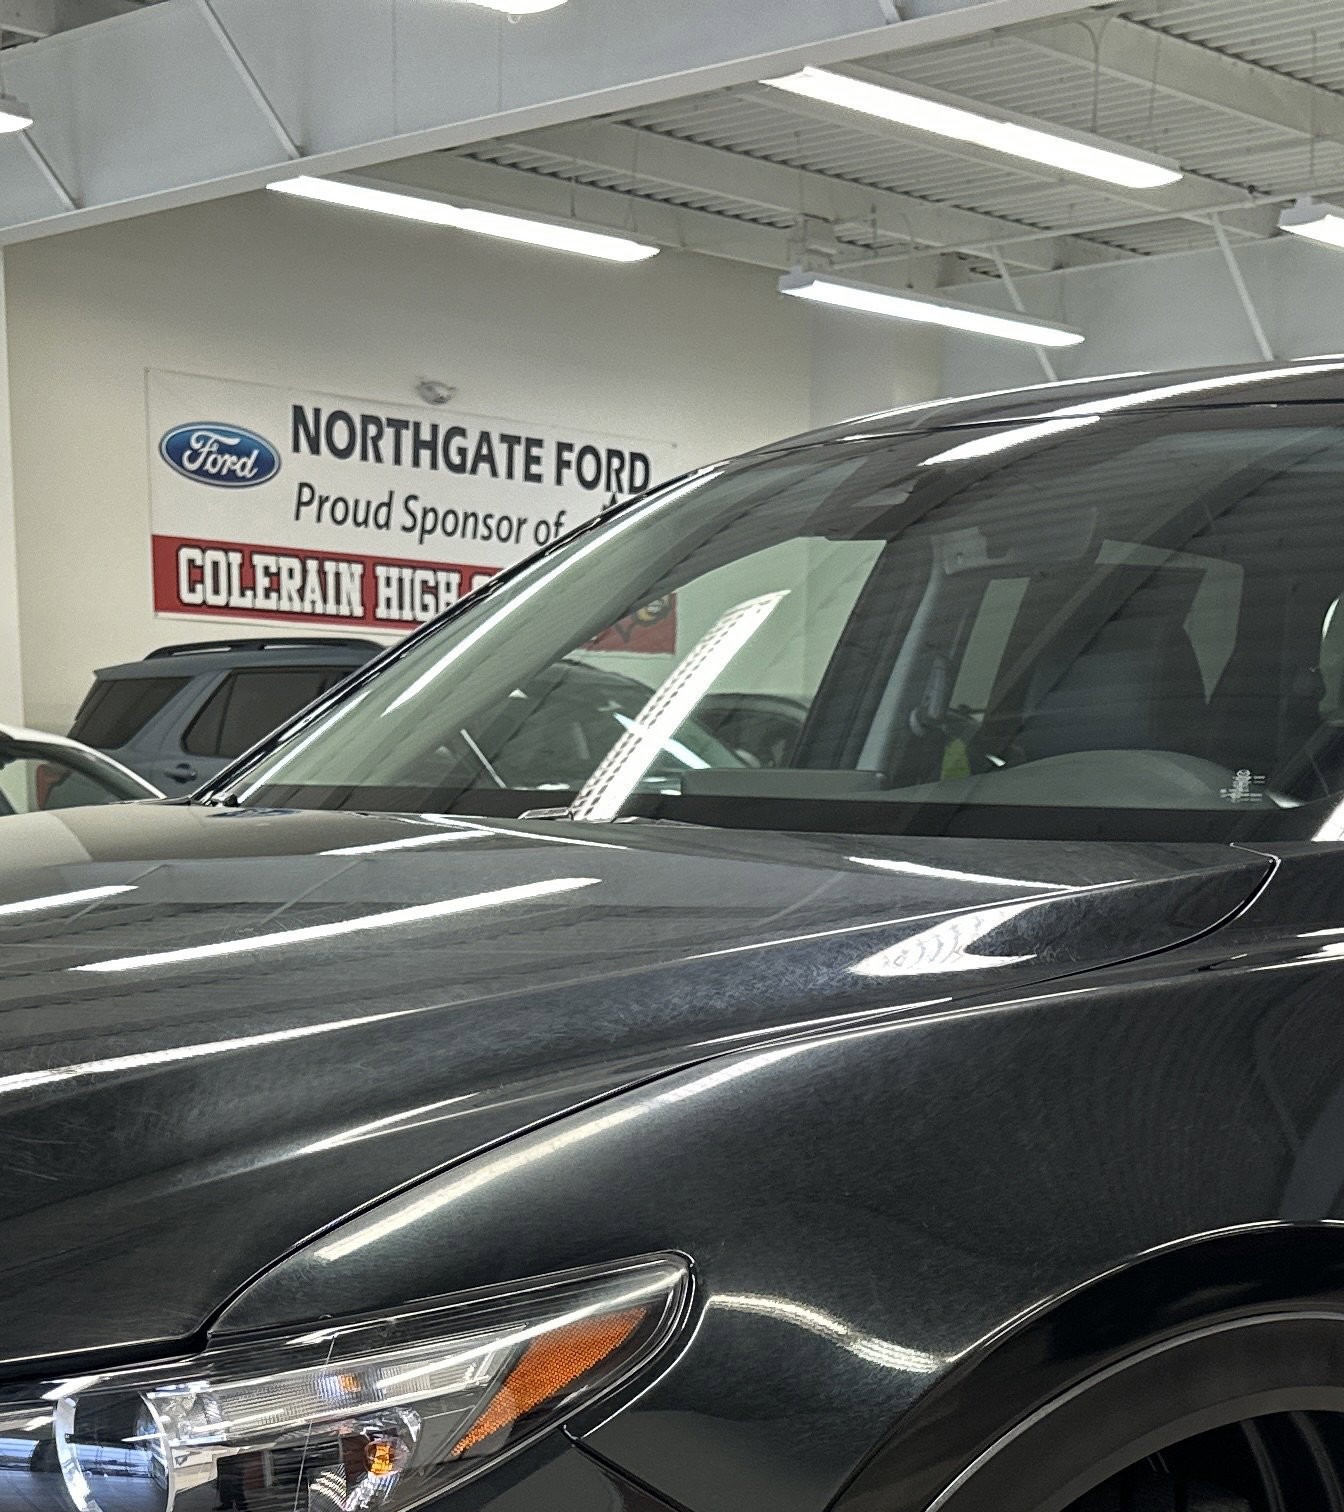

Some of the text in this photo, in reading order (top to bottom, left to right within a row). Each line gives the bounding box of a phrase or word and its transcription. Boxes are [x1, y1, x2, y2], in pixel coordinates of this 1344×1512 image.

[182, 430, 259, 479] Ford
[291, 404, 651, 495] NORTHGATE FORD
[294, 482, 567, 546] Proud Sponsor of
[177, 546, 463, 622] COLERAIN HIGH
